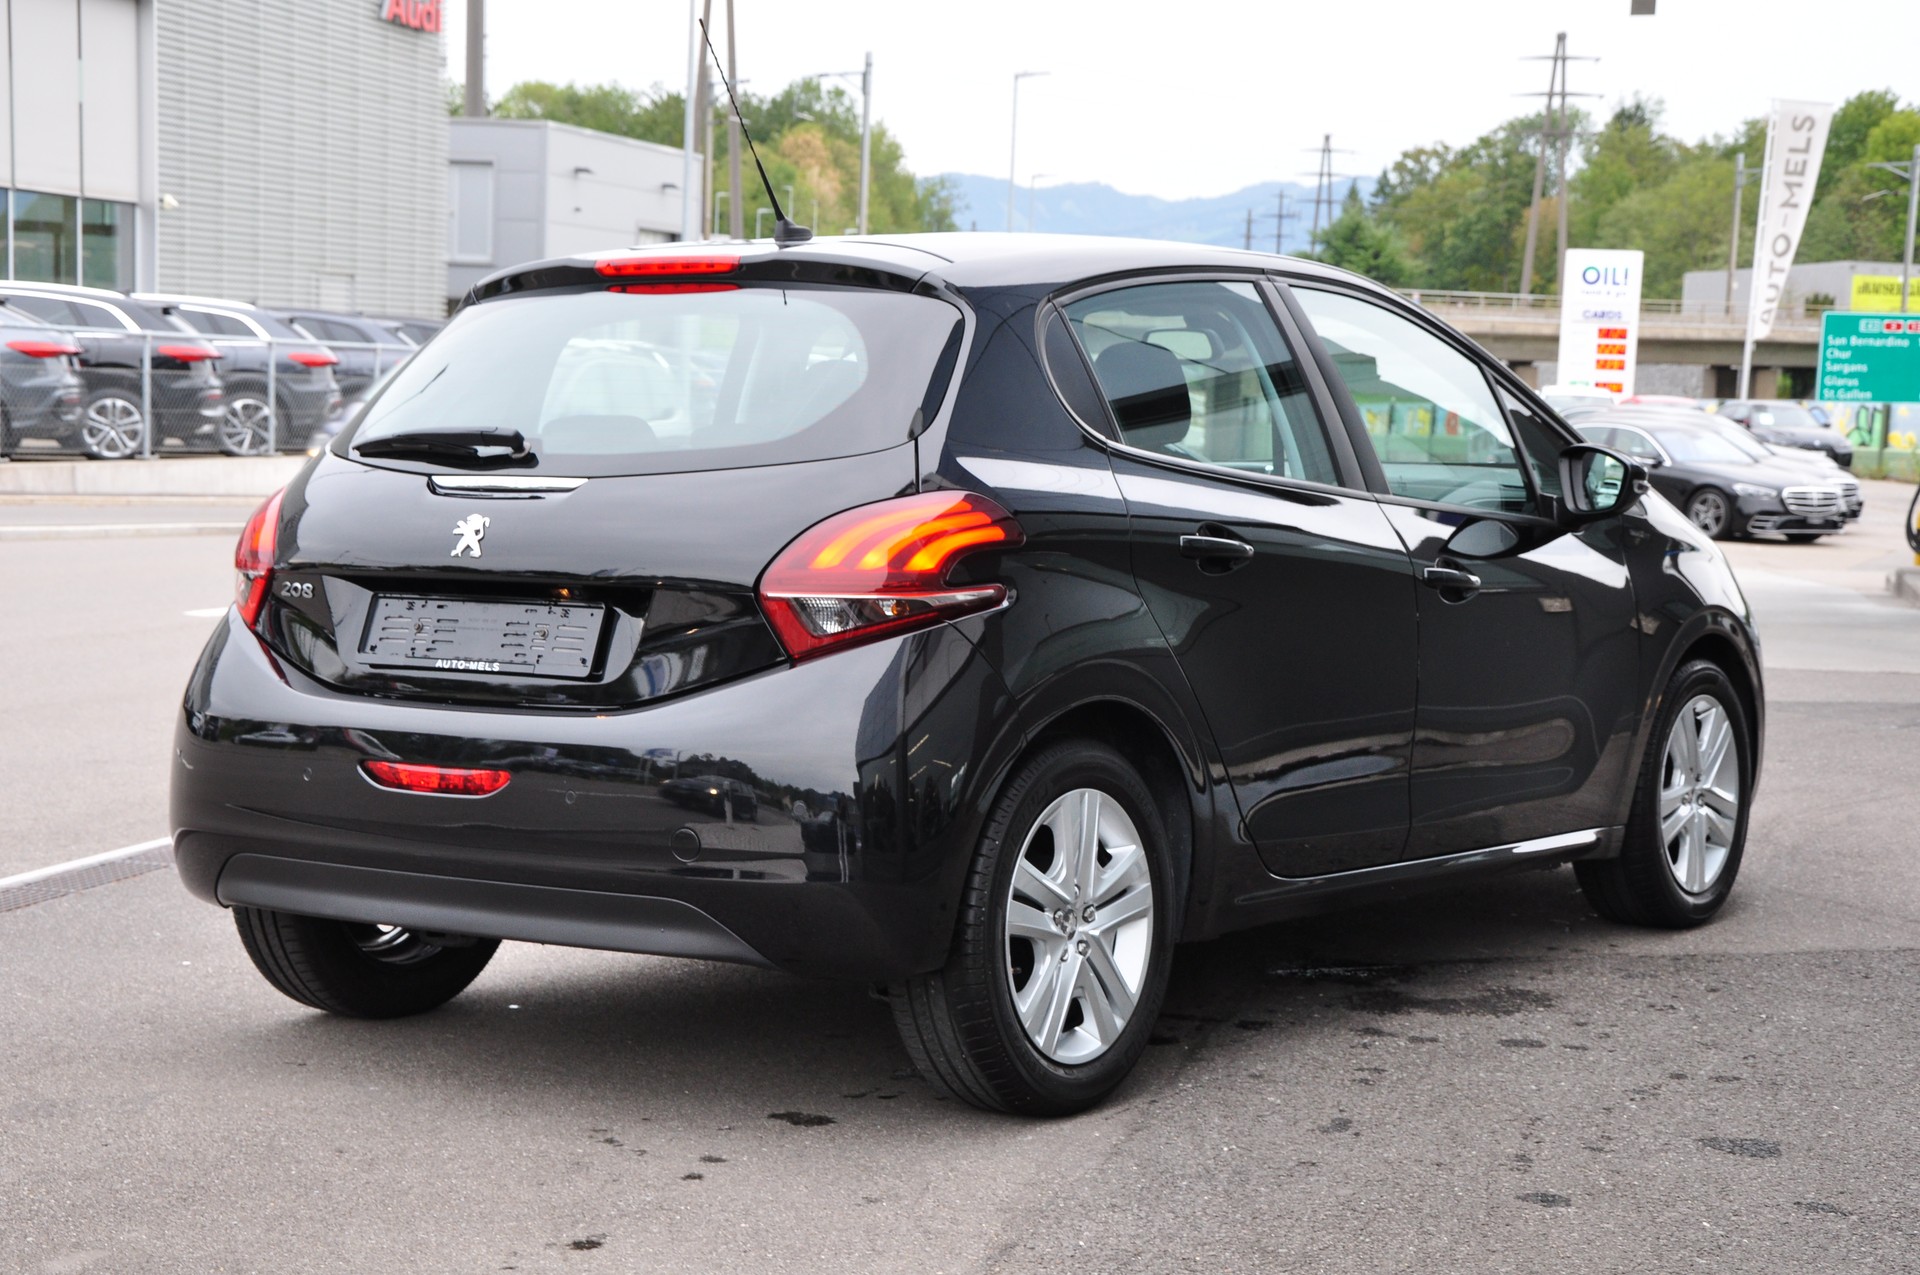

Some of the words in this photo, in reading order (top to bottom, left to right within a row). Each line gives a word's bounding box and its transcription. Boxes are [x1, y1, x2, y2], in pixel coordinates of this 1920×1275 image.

[1582, 266, 1628, 286] OIL!
[1849, 335, 1910, 348] Bernardino
[1826, 347, 1852, 359] Chur
[1825, 361, 1868, 374] Sargans
[1824, 375, 1859, 387] Glarus
[281, 581, 313, 599] 208
[435, 659, 500, 672] AUTO-MELS
